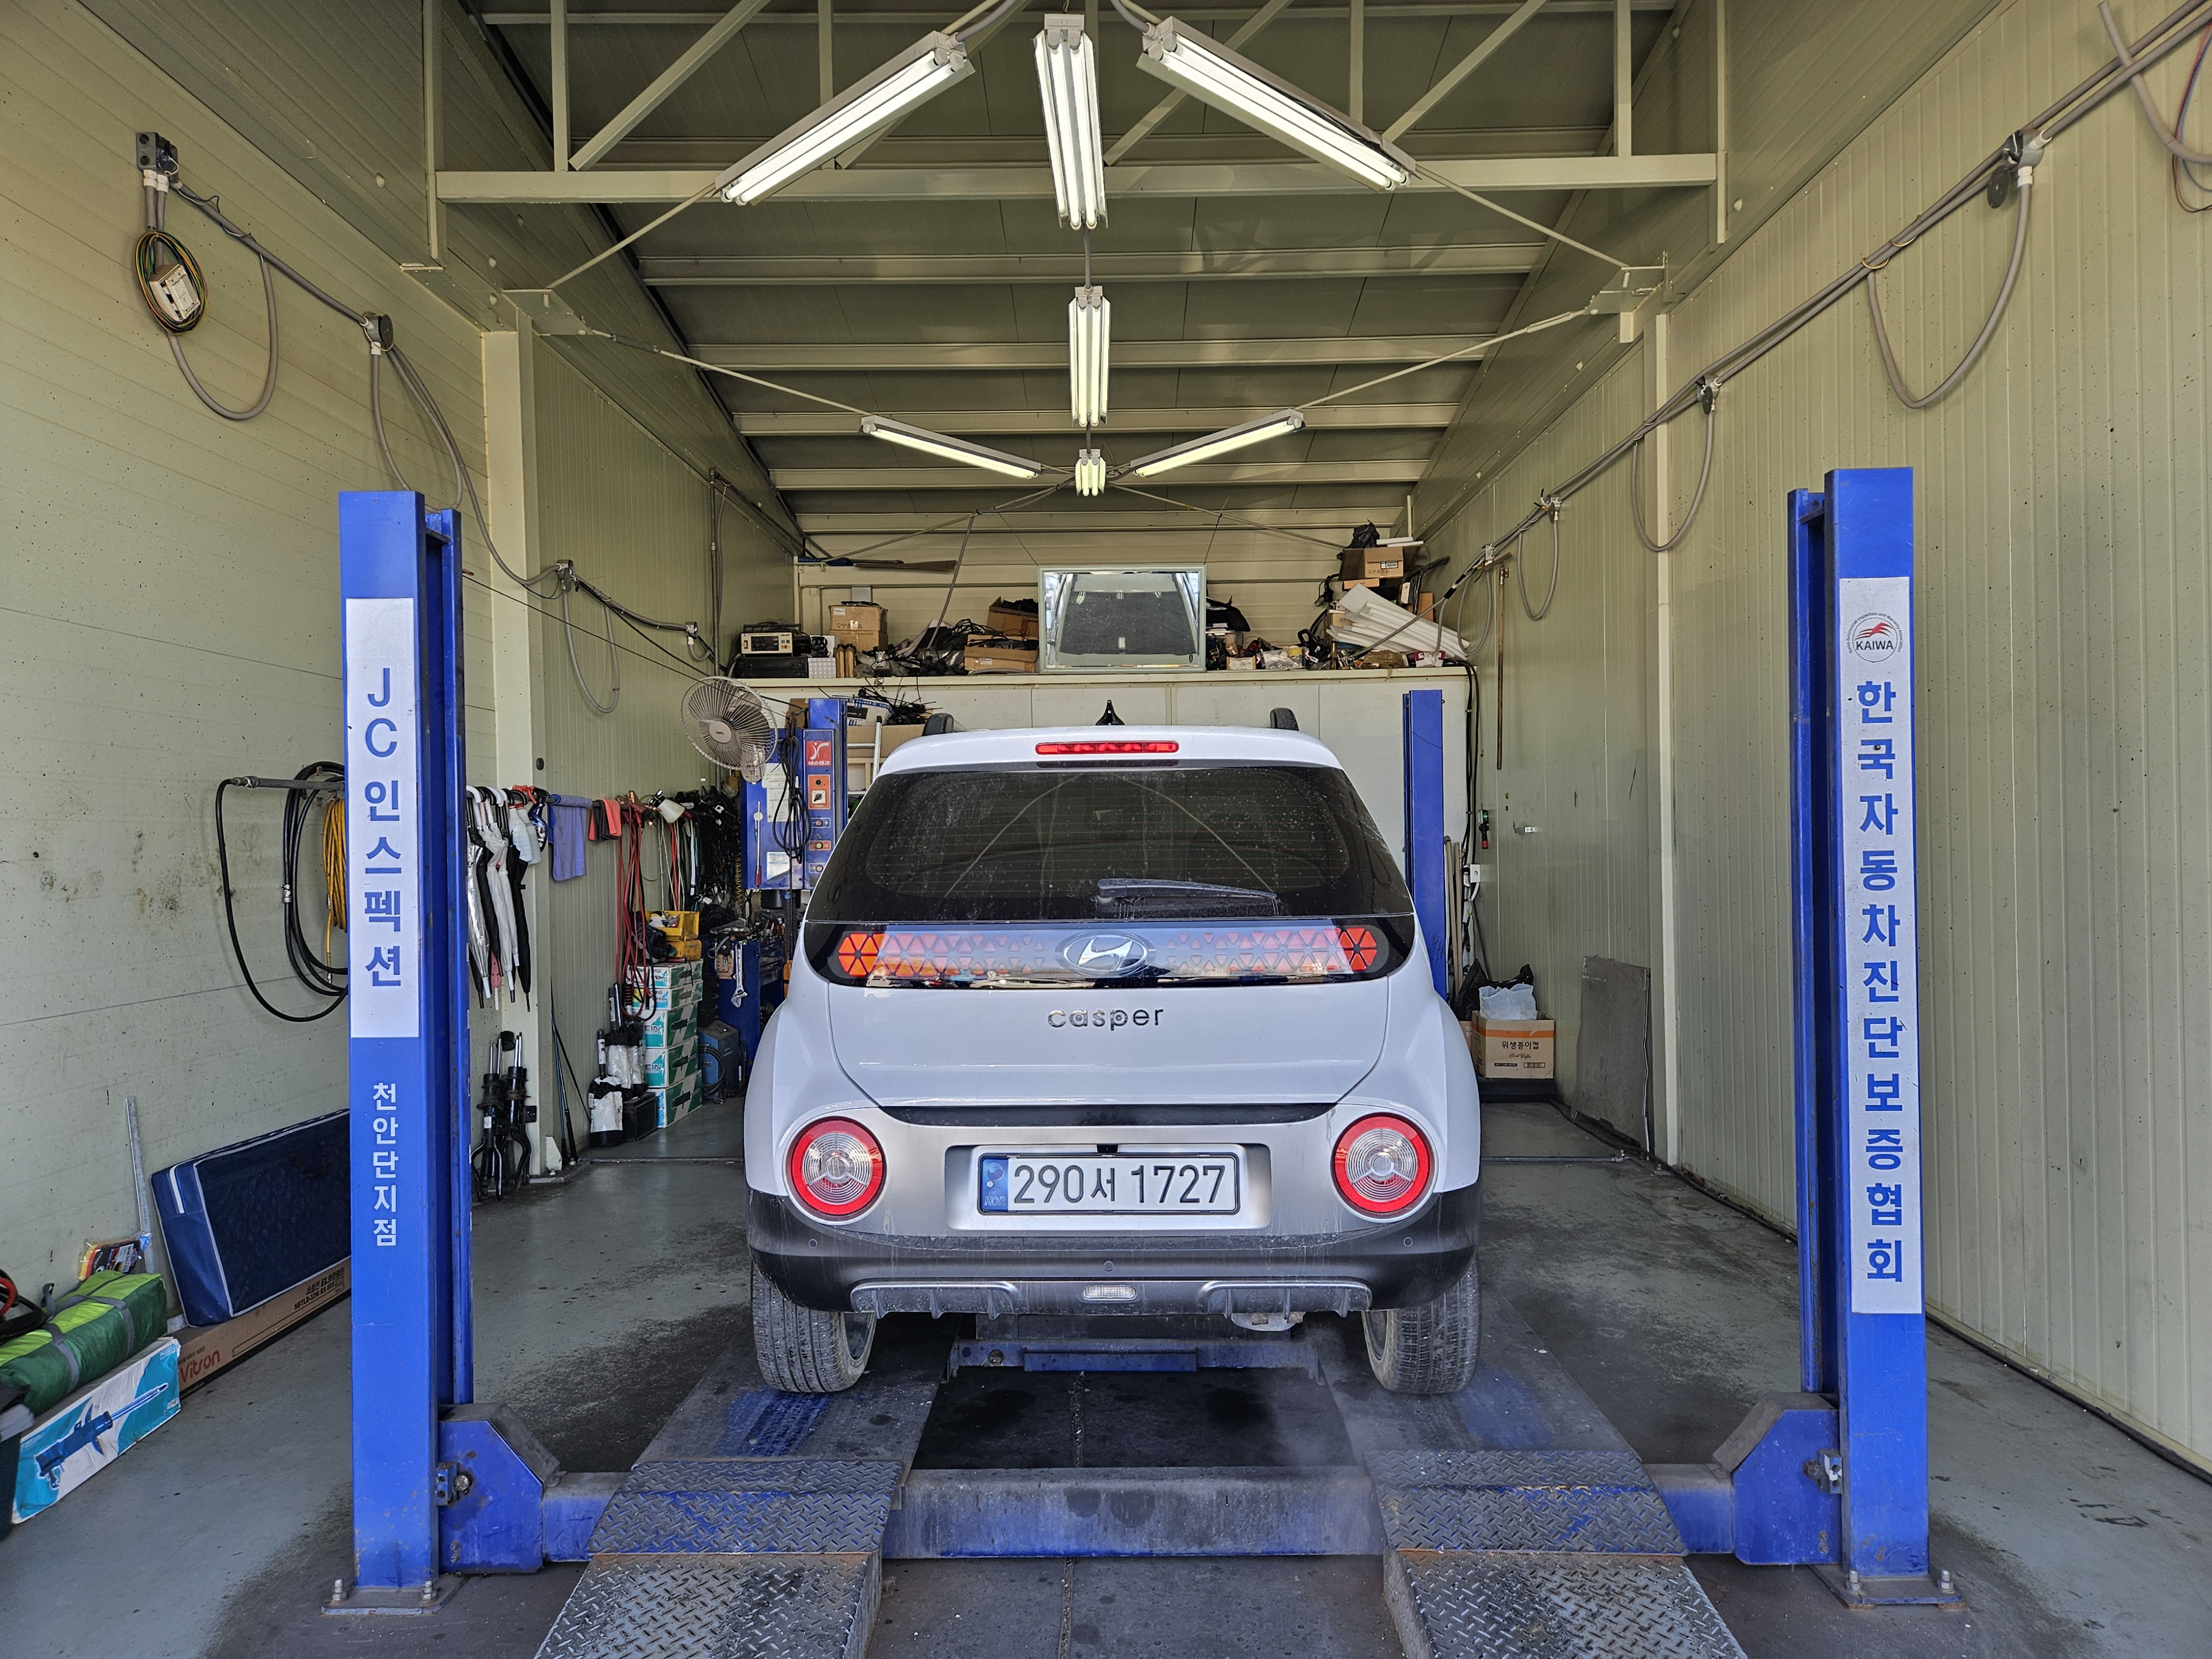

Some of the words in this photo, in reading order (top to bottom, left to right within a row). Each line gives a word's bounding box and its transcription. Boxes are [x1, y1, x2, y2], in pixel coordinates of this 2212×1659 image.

[1846, 619, 1858, 641] Automotive
[1857, 612, 1878, 621] Inspection
[1886, 615, 1901, 630] Warranty
[1856, 640, 1894, 650] KAIWA
[1857, 681, 1903, 1282] 한국자동차진단보증협회
[1048, 1009, 1164, 1031] casper
[1502, 1041, 1539, 1050] 위생종이컵
[373, 1082, 399, 1246] 천안단지점
[1014, 1165, 1116, 1204] 290서
[1131, 1165, 1225, 1204] 1727
[984, 1196, 1006, 1207] KOR
[180, 1350, 220, 1383] Vitron
